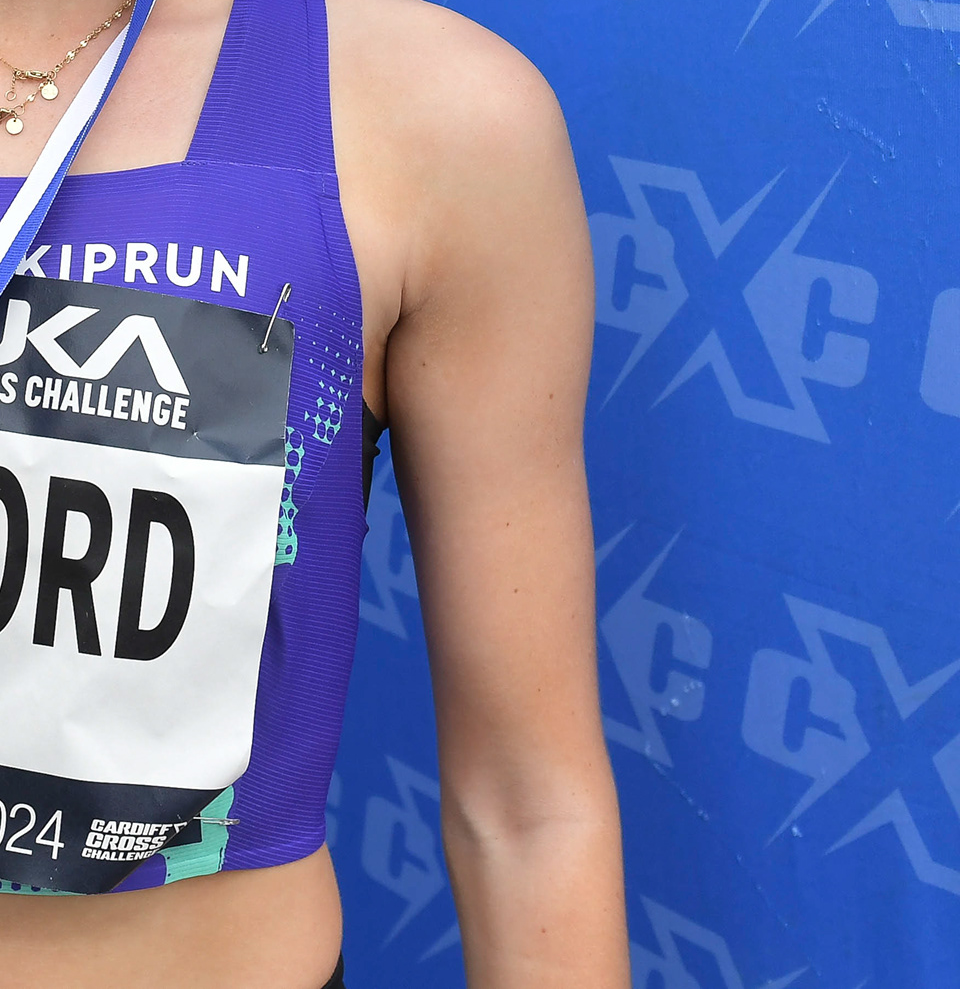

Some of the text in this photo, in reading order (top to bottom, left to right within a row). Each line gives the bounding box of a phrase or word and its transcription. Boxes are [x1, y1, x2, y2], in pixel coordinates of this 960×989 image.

[25, 375, 189, 430] CHALLENGE
[90, 818, 172, 836] CARDIFF
[85, 831, 167, 851] CROSS
[81, 847, 160, 861] CHALLENG
